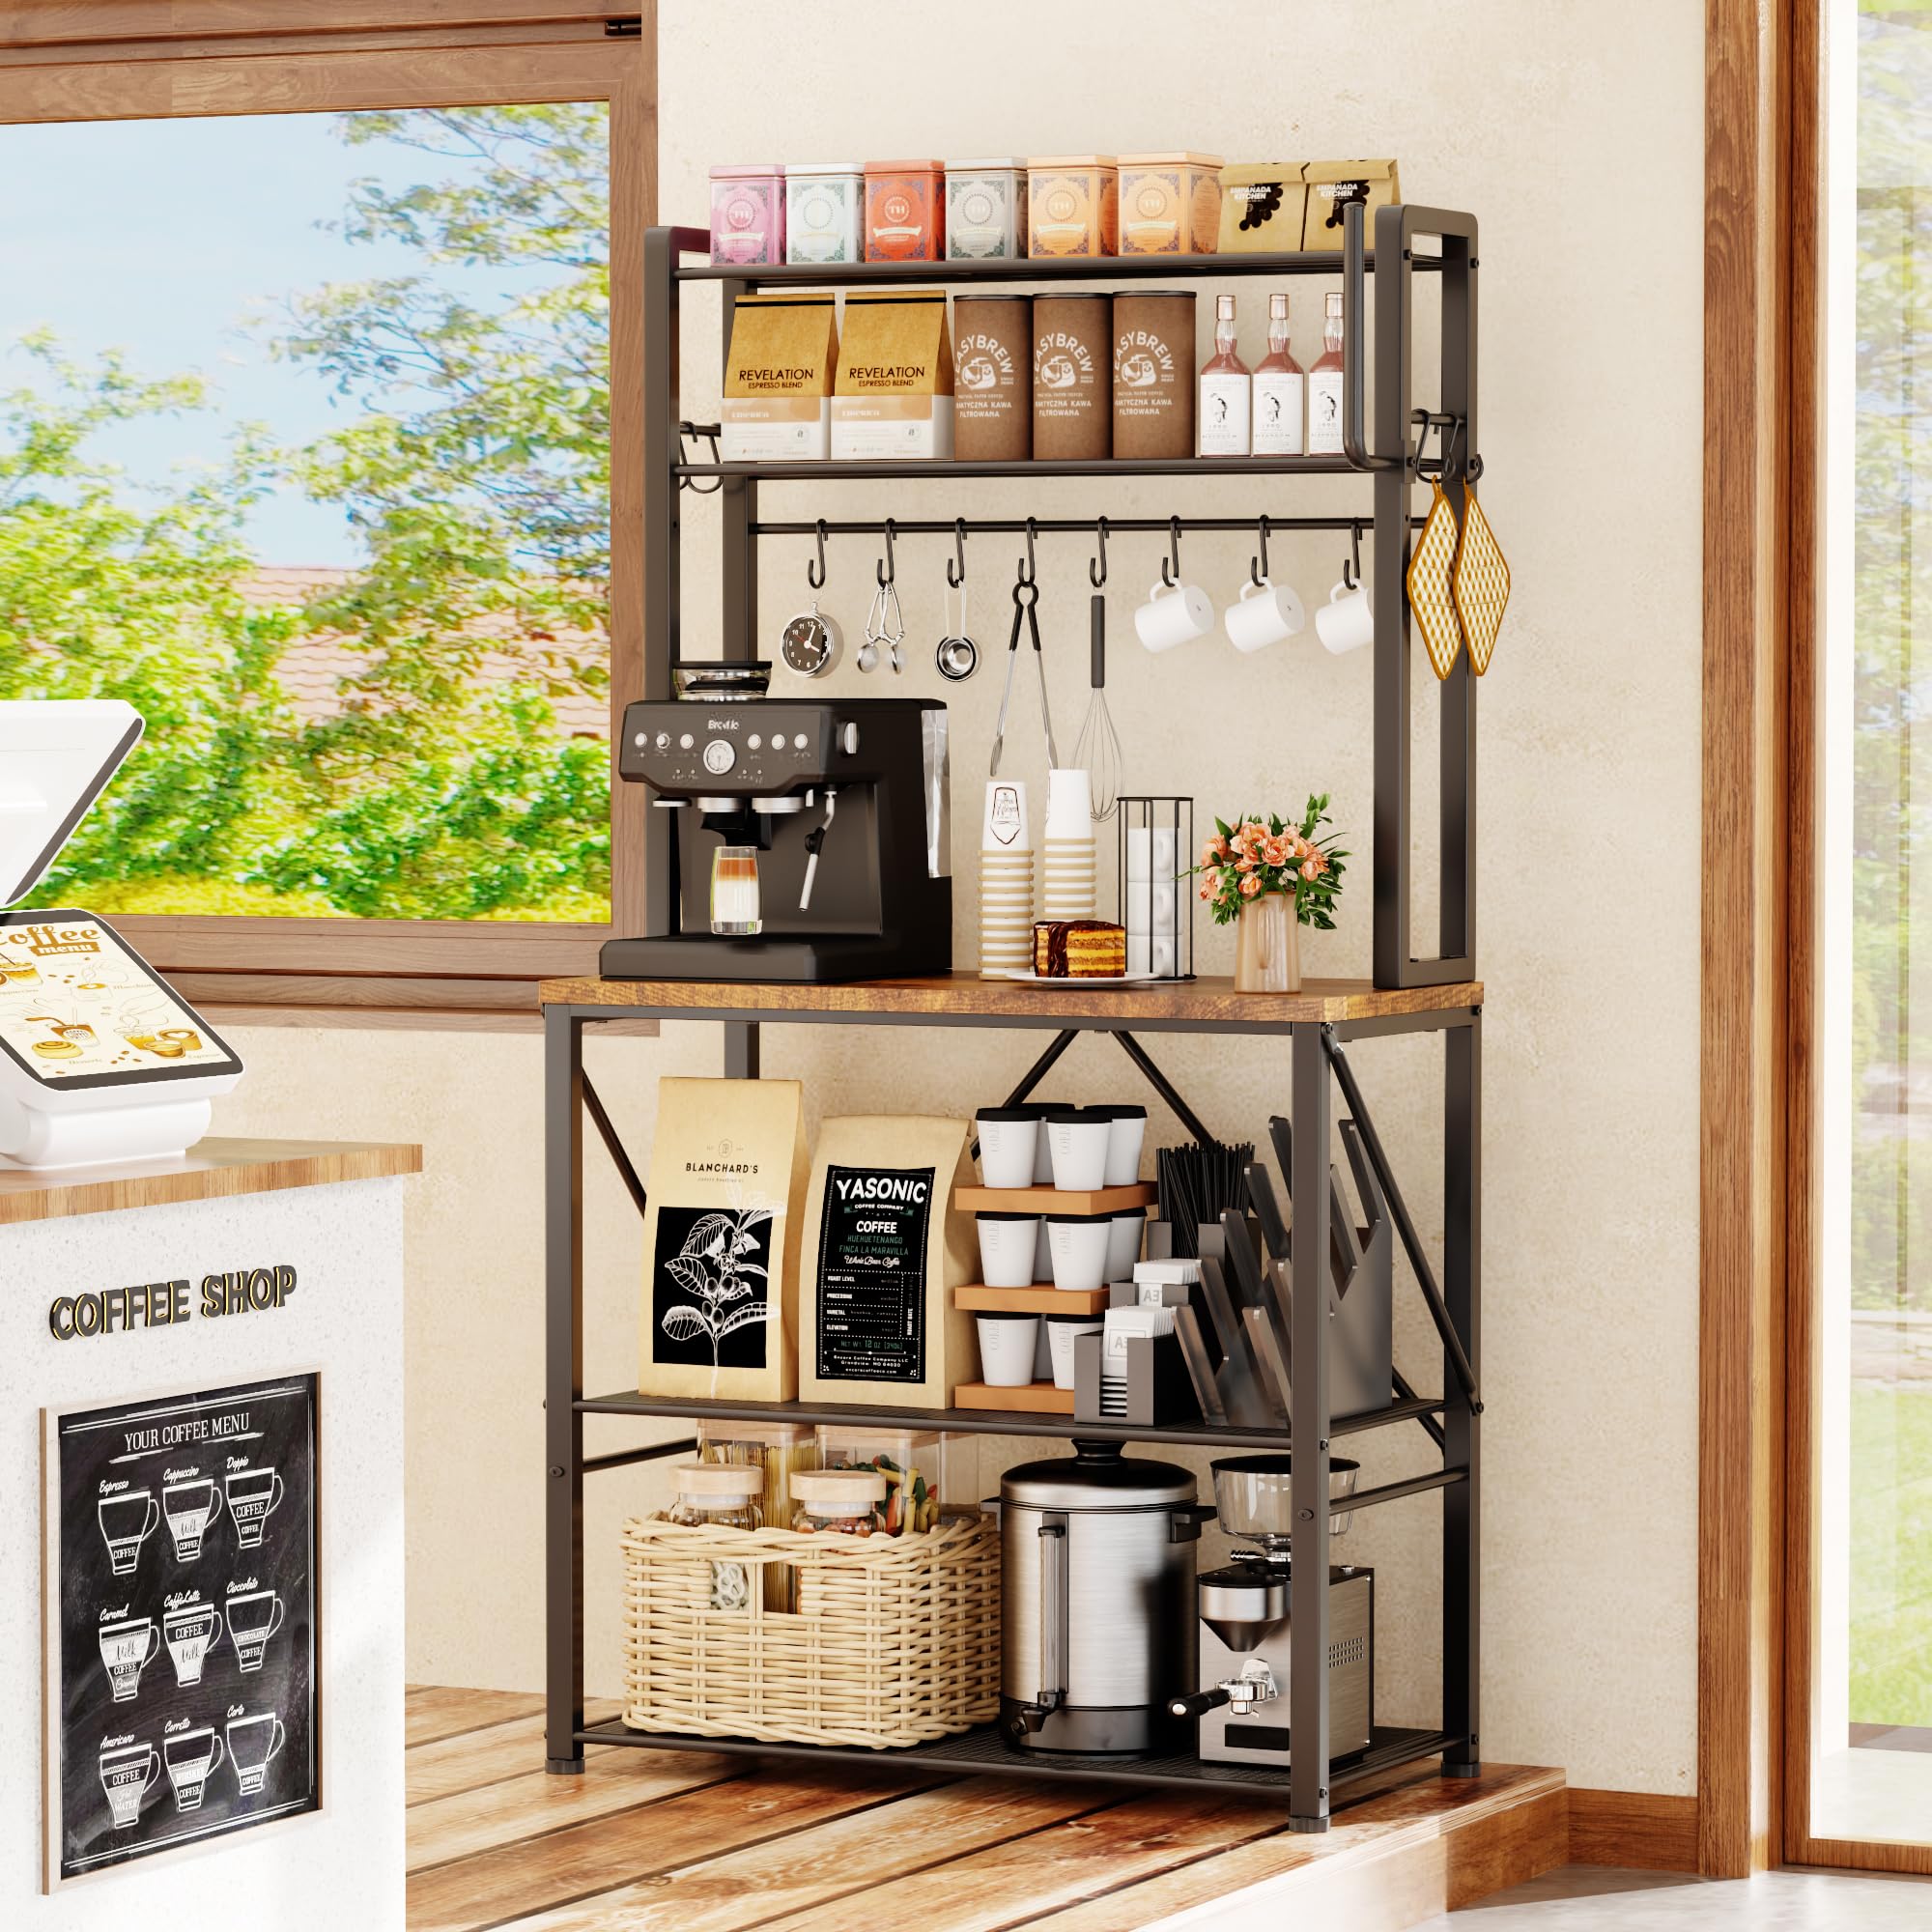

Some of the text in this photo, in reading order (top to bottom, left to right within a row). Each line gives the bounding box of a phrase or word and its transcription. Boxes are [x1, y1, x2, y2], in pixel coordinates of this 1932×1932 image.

[954, 334, 1013, 373] EASYBREW
[1035, 332, 1094, 372] EASYBREW
[1115, 330, 1174, 371] EASYBREW
[739, 369, 813, 381] REVELATION
[849, 366, 924, 379] REVELATION
[39, 944, 94, 954] menu
[686, 1162, 758, 1175] BLANCHARD'S
[836, 1178, 927, 1204] YASONIC
[856, 1220, 897, 1234] COFFEE
[847, 1235, 903, 1244] HUEHUETENANGO
[871, 1247, 909, 1256] MARAVILLA
[49, 1264, 298, 1341] COFFEE SHOP
[125, 1412, 250, 1452] YOUR COFFEE MENU
[163, 1466, 199, 1485] Cappuccino
[99, 1480, 129, 1496] Espresso
[236, 1502, 265, 1519] COFFEE
[241, 1524, 260, 1535] COFFEE
[179, 1540, 199, 1551] COFFEE
[113, 1547, 136, 1560] COFFEE
[175, 1623, 204, 1639] COFFEE
[237, 1630, 265, 1643] CHOCOLATE
[240, 1646, 262, 1659] COFFEE
[113, 1662, 137, 1676] COFFEE
[99, 1734, 135, 1750] Americano
[113, 1769, 140, 1786] COFFEE
[242, 1774, 261, 1786] COFFEE
[179, 1785, 201, 1799] COFFEE
[115, 1799, 138, 1812] WATER
